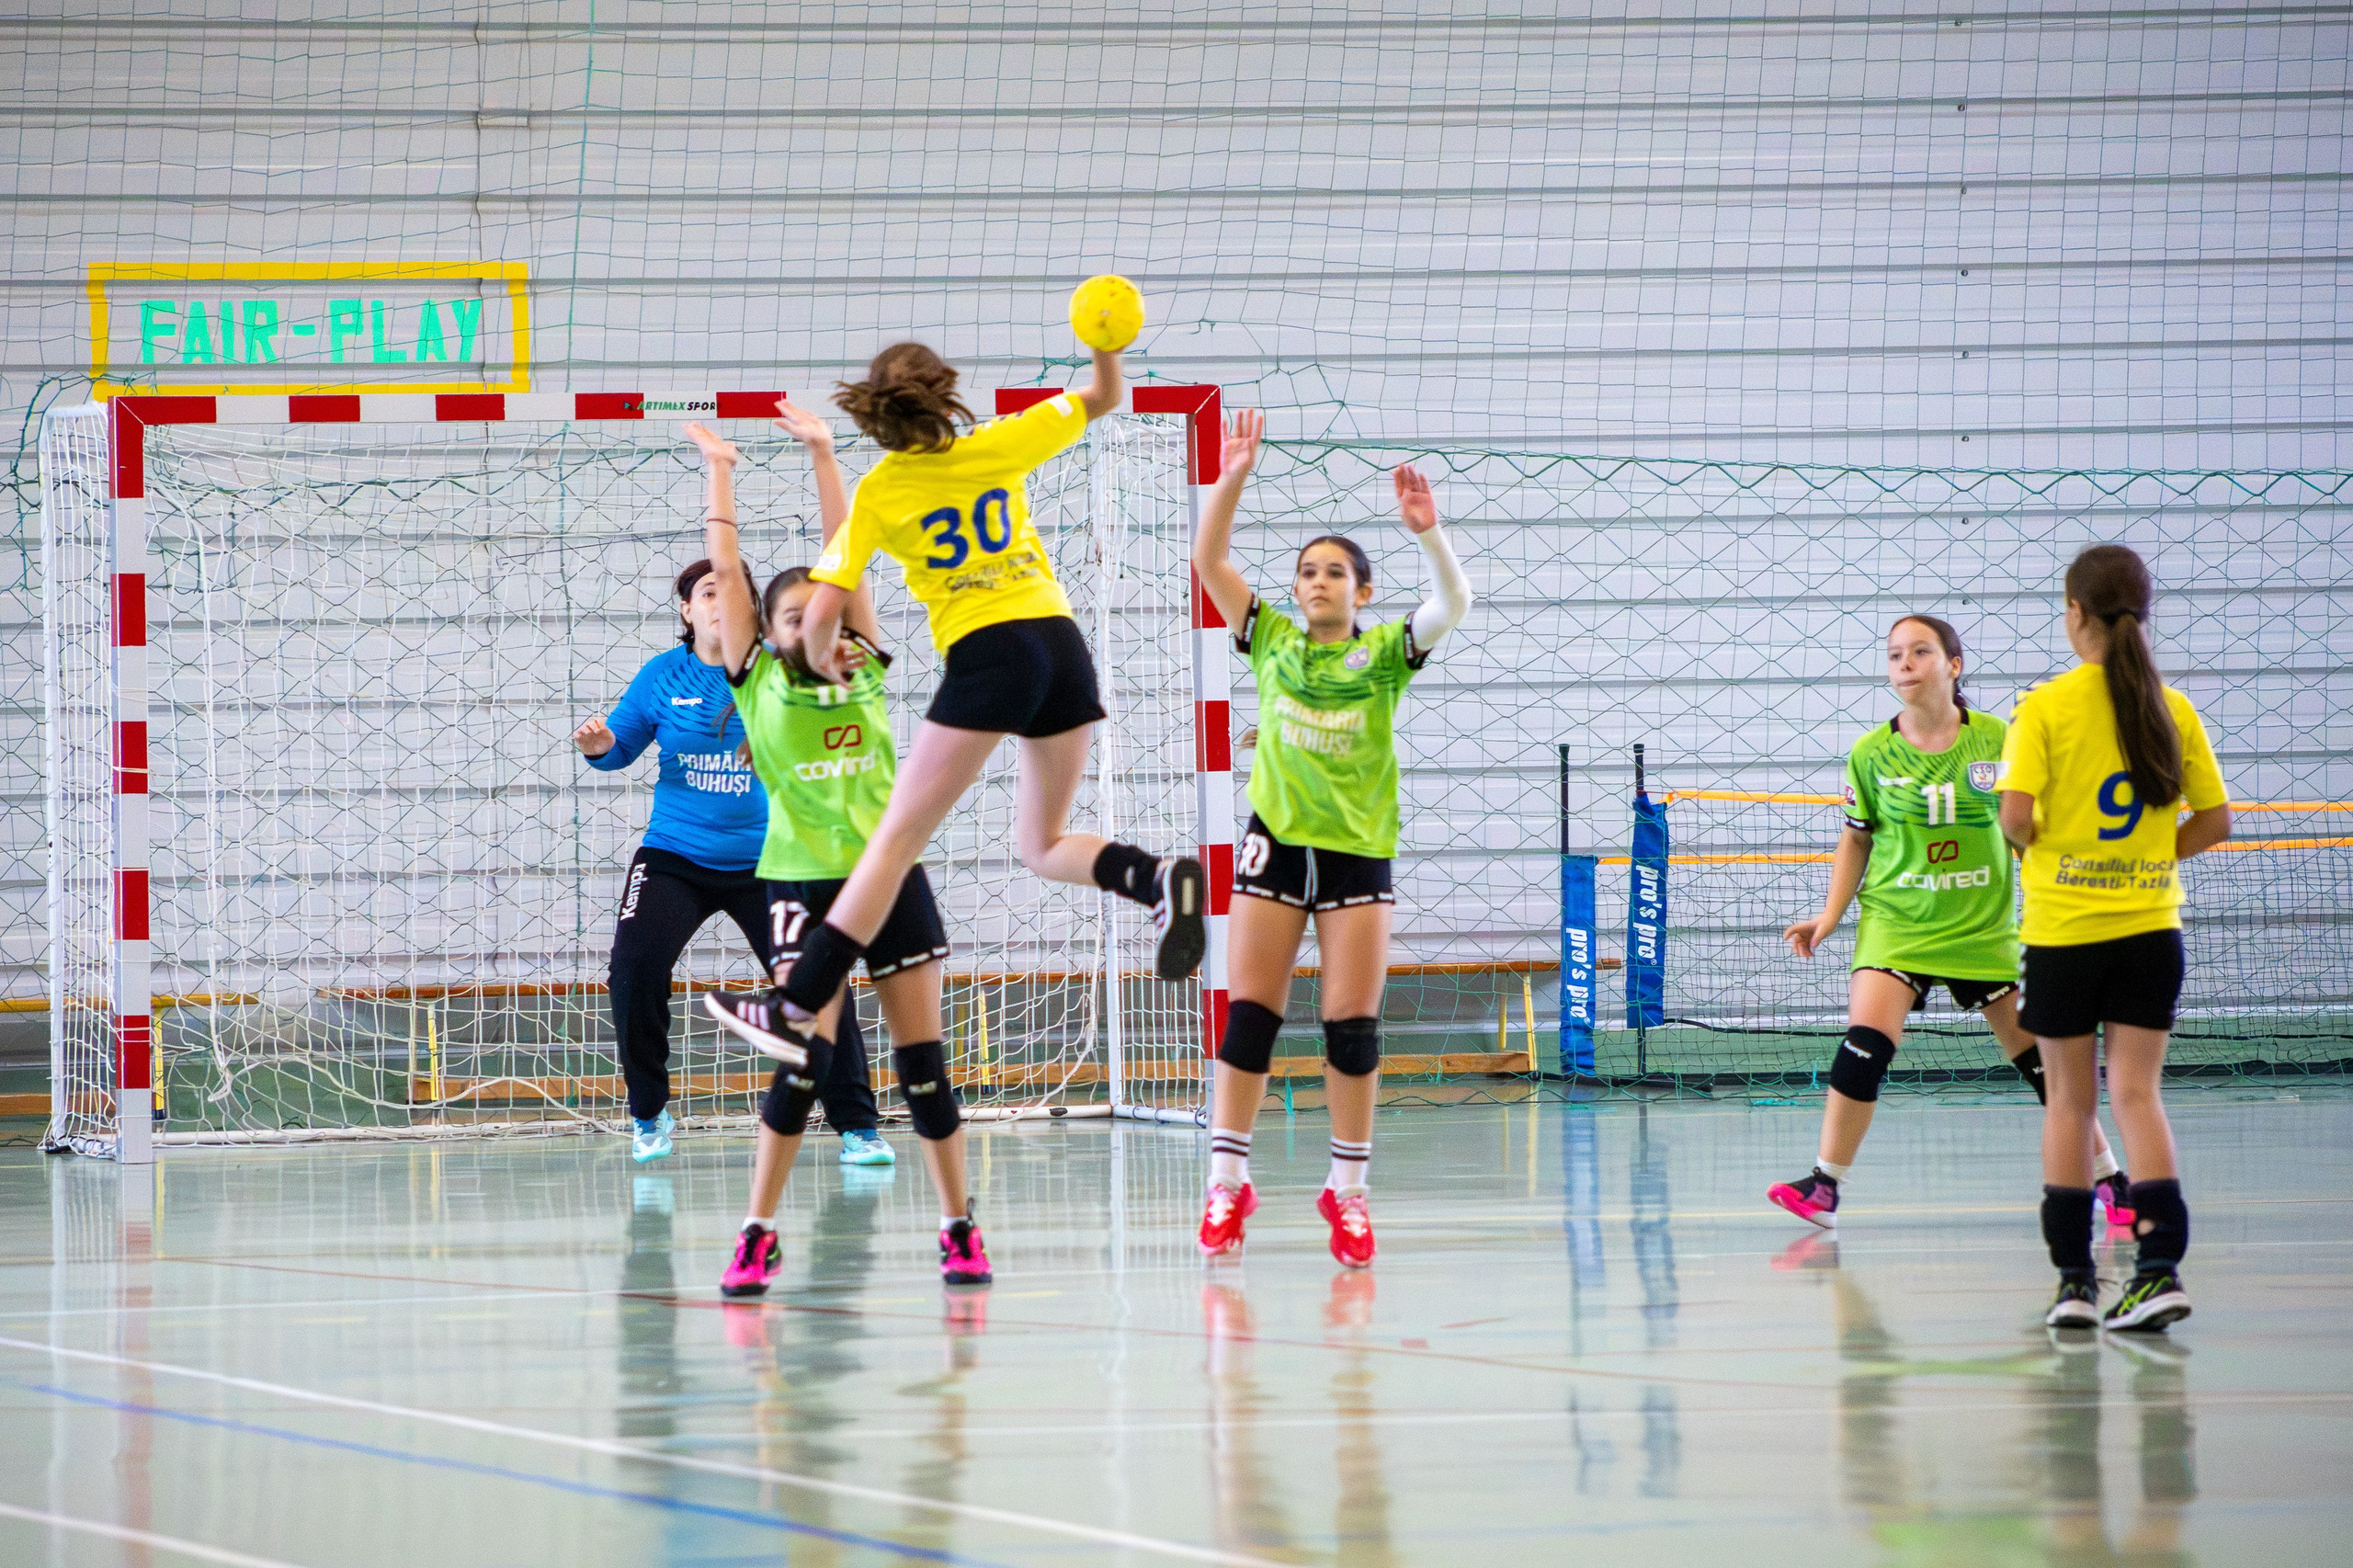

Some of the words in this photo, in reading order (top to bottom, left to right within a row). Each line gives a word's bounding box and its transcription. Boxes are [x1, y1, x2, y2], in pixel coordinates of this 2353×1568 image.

[141, 299, 483, 364] FAIR-PLAY
[920, 487, 1012, 569] 30
[1920, 781, 1956, 825] 11
[2097, 770, 2144, 841] 9
[620, 862, 649, 921] Kempa
[1896, 865, 1990, 892] covired
[769, 899, 811, 947] 17
[1565, 927, 1592, 981] pro's
